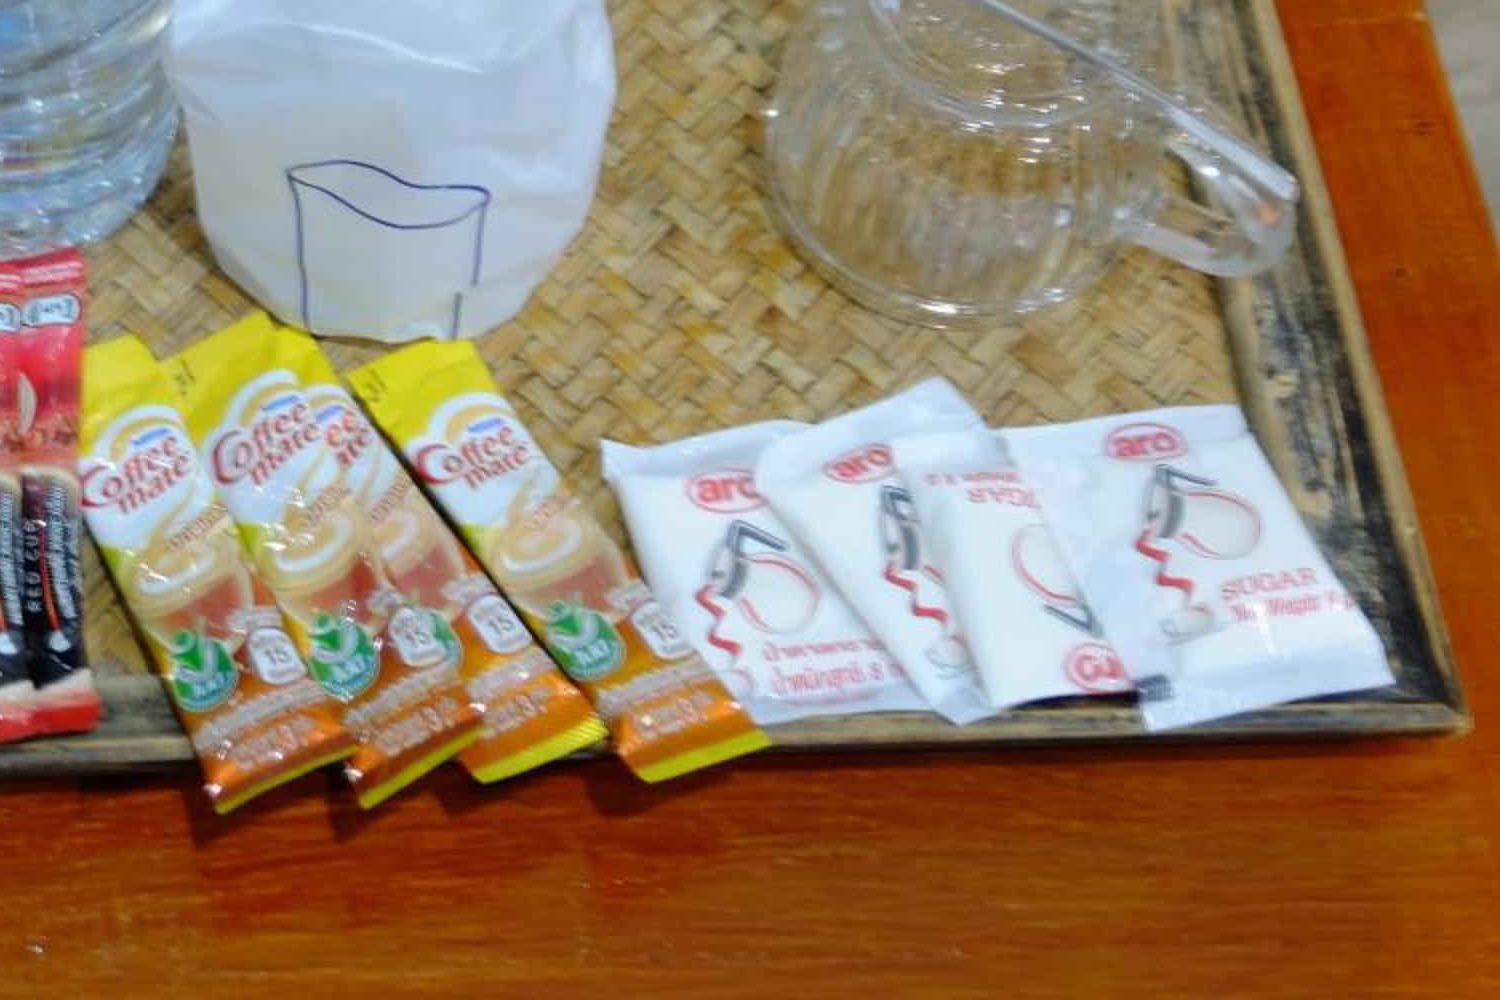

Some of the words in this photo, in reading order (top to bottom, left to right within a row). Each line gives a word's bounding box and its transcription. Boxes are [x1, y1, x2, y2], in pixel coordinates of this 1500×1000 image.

[1114, 431, 1180, 458] aro
[832, 446, 893, 478] aro
[1220, 567, 1317, 600] SUGAR
